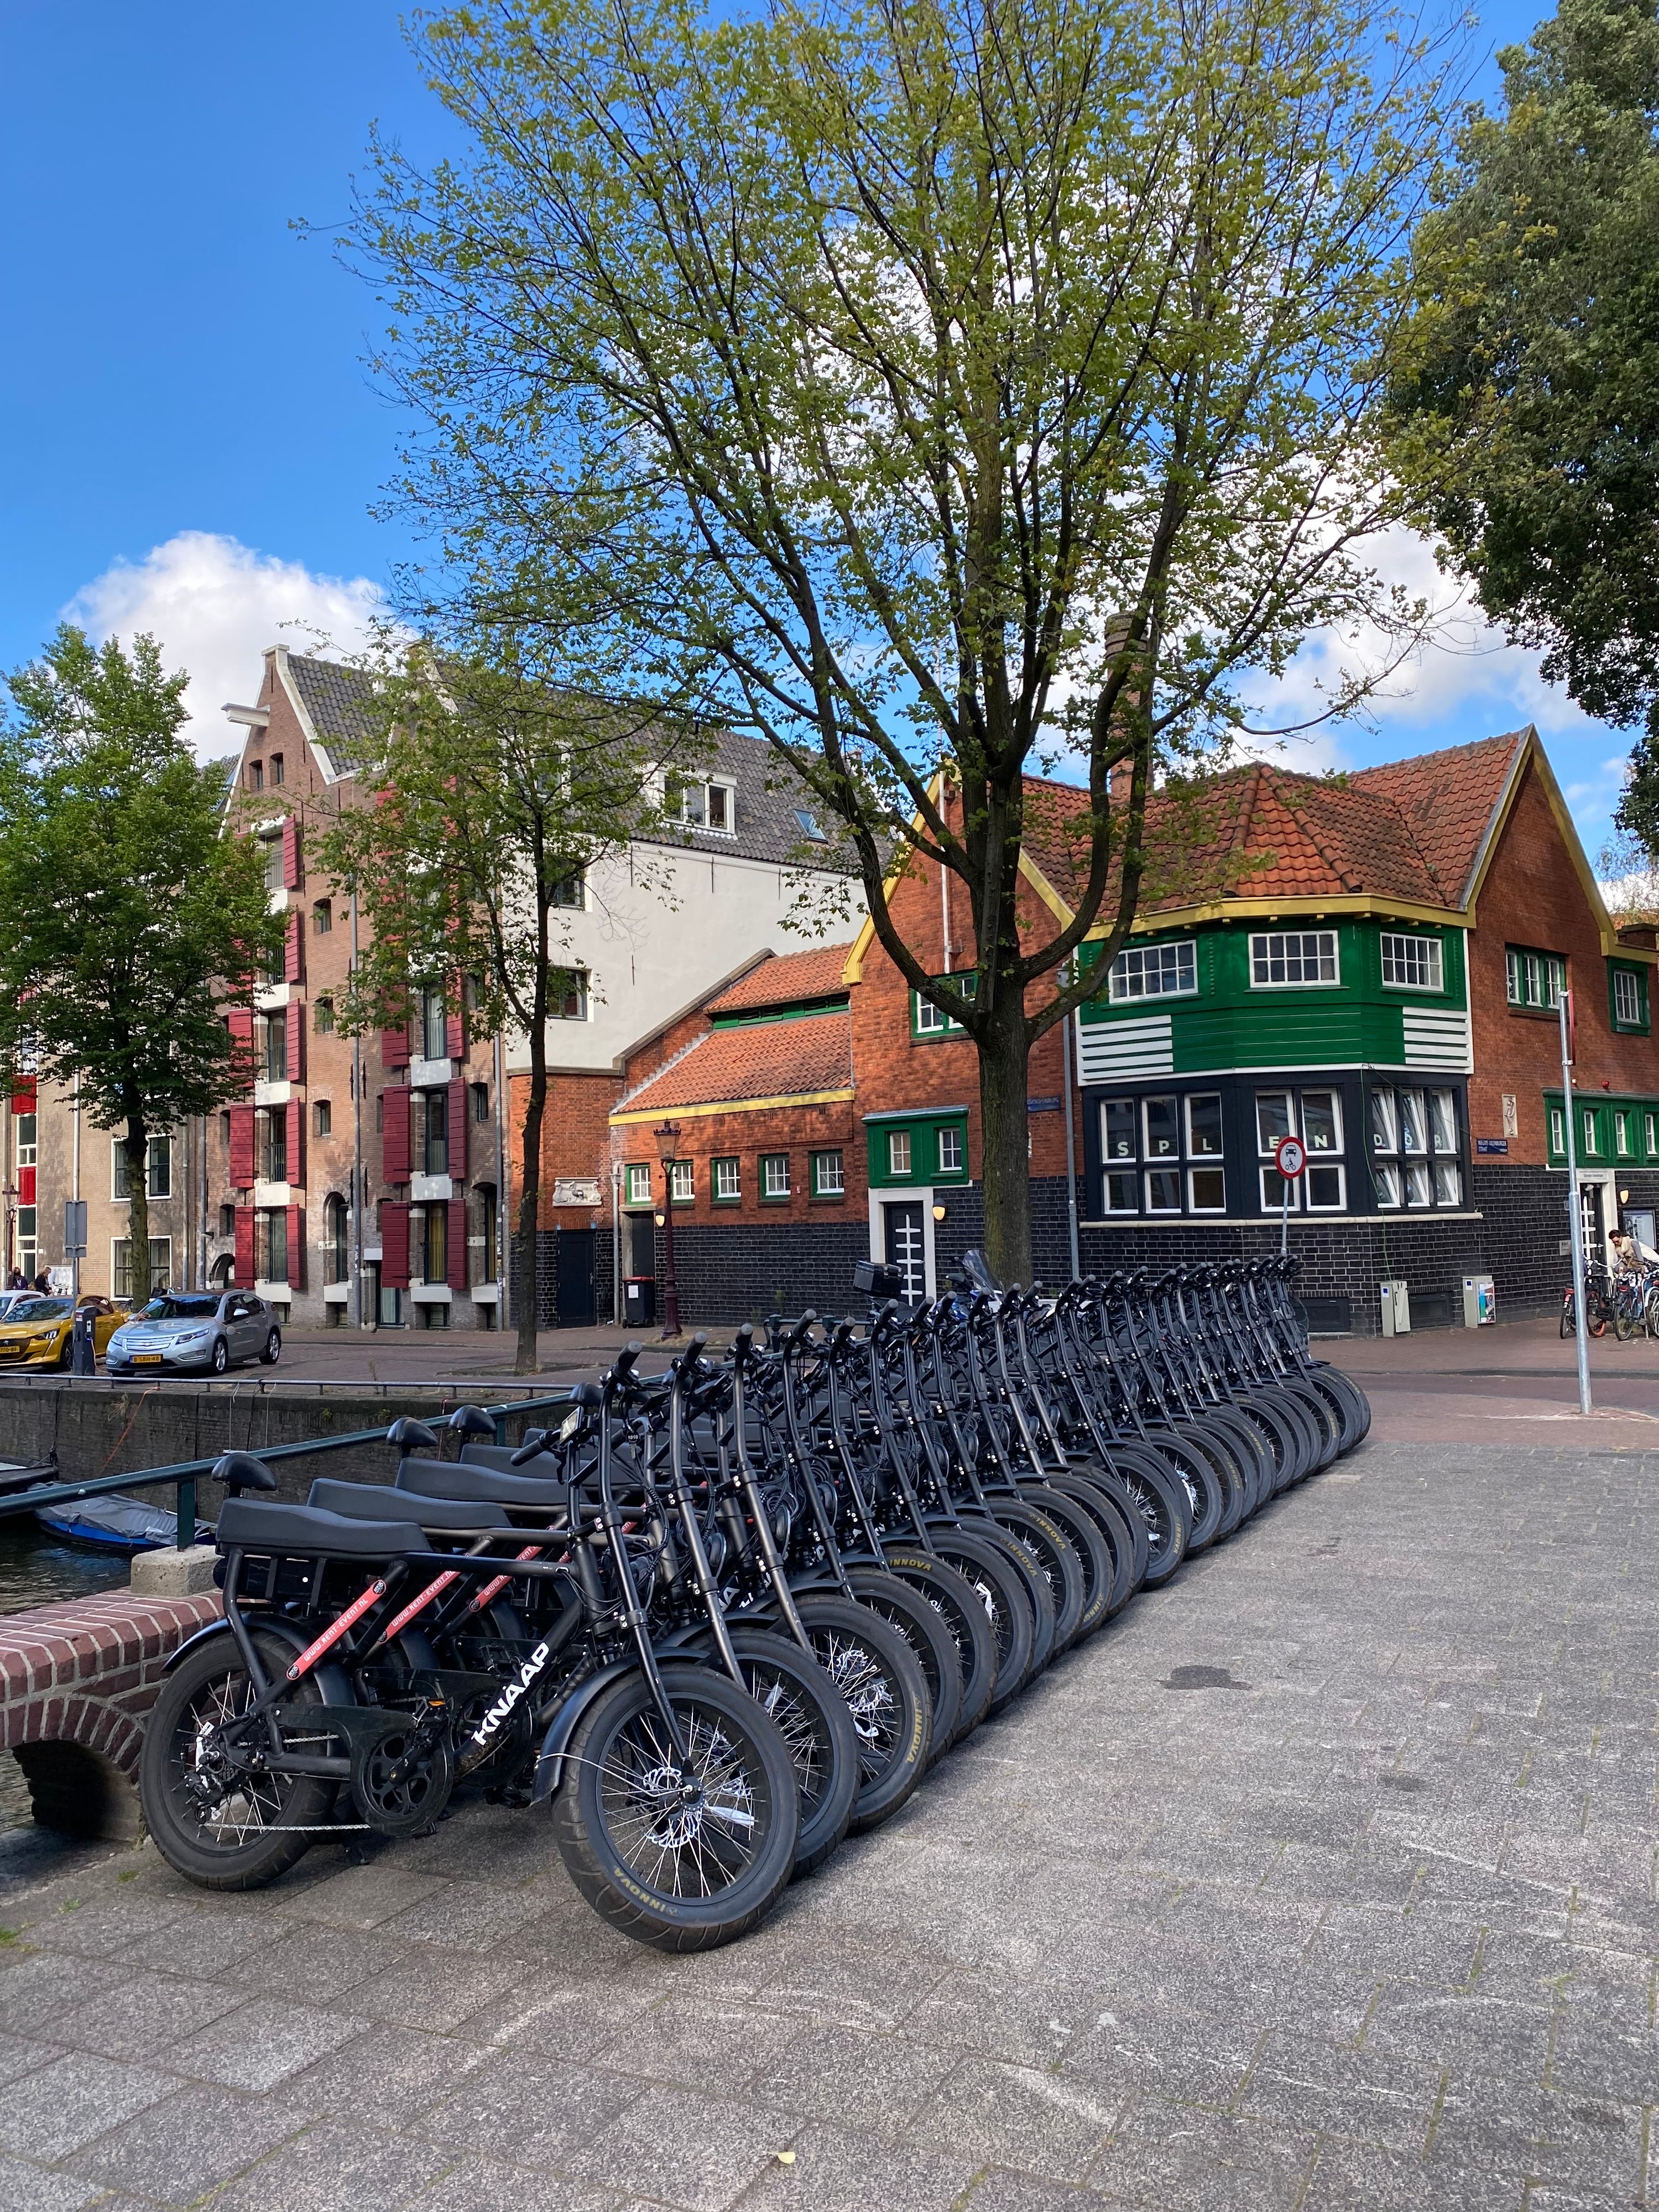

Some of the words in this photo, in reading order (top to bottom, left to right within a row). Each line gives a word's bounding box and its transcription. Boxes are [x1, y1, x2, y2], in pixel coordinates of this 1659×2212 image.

[1035, 1517, 1066, 1551] INNOVA
[889, 1558, 932, 1571] INNOVA
[1007, 1541, 1037, 1577] INNOVA
[304, 1598, 369, 1662] WWW.RENT-EVENT.NL
[1083, 1600, 1102, 1623] INNO
[471, 1642, 550, 1746] KNAAP
[906, 1708, 923, 1764] INNOVA
[614, 1867, 666, 1913] INNOVA
